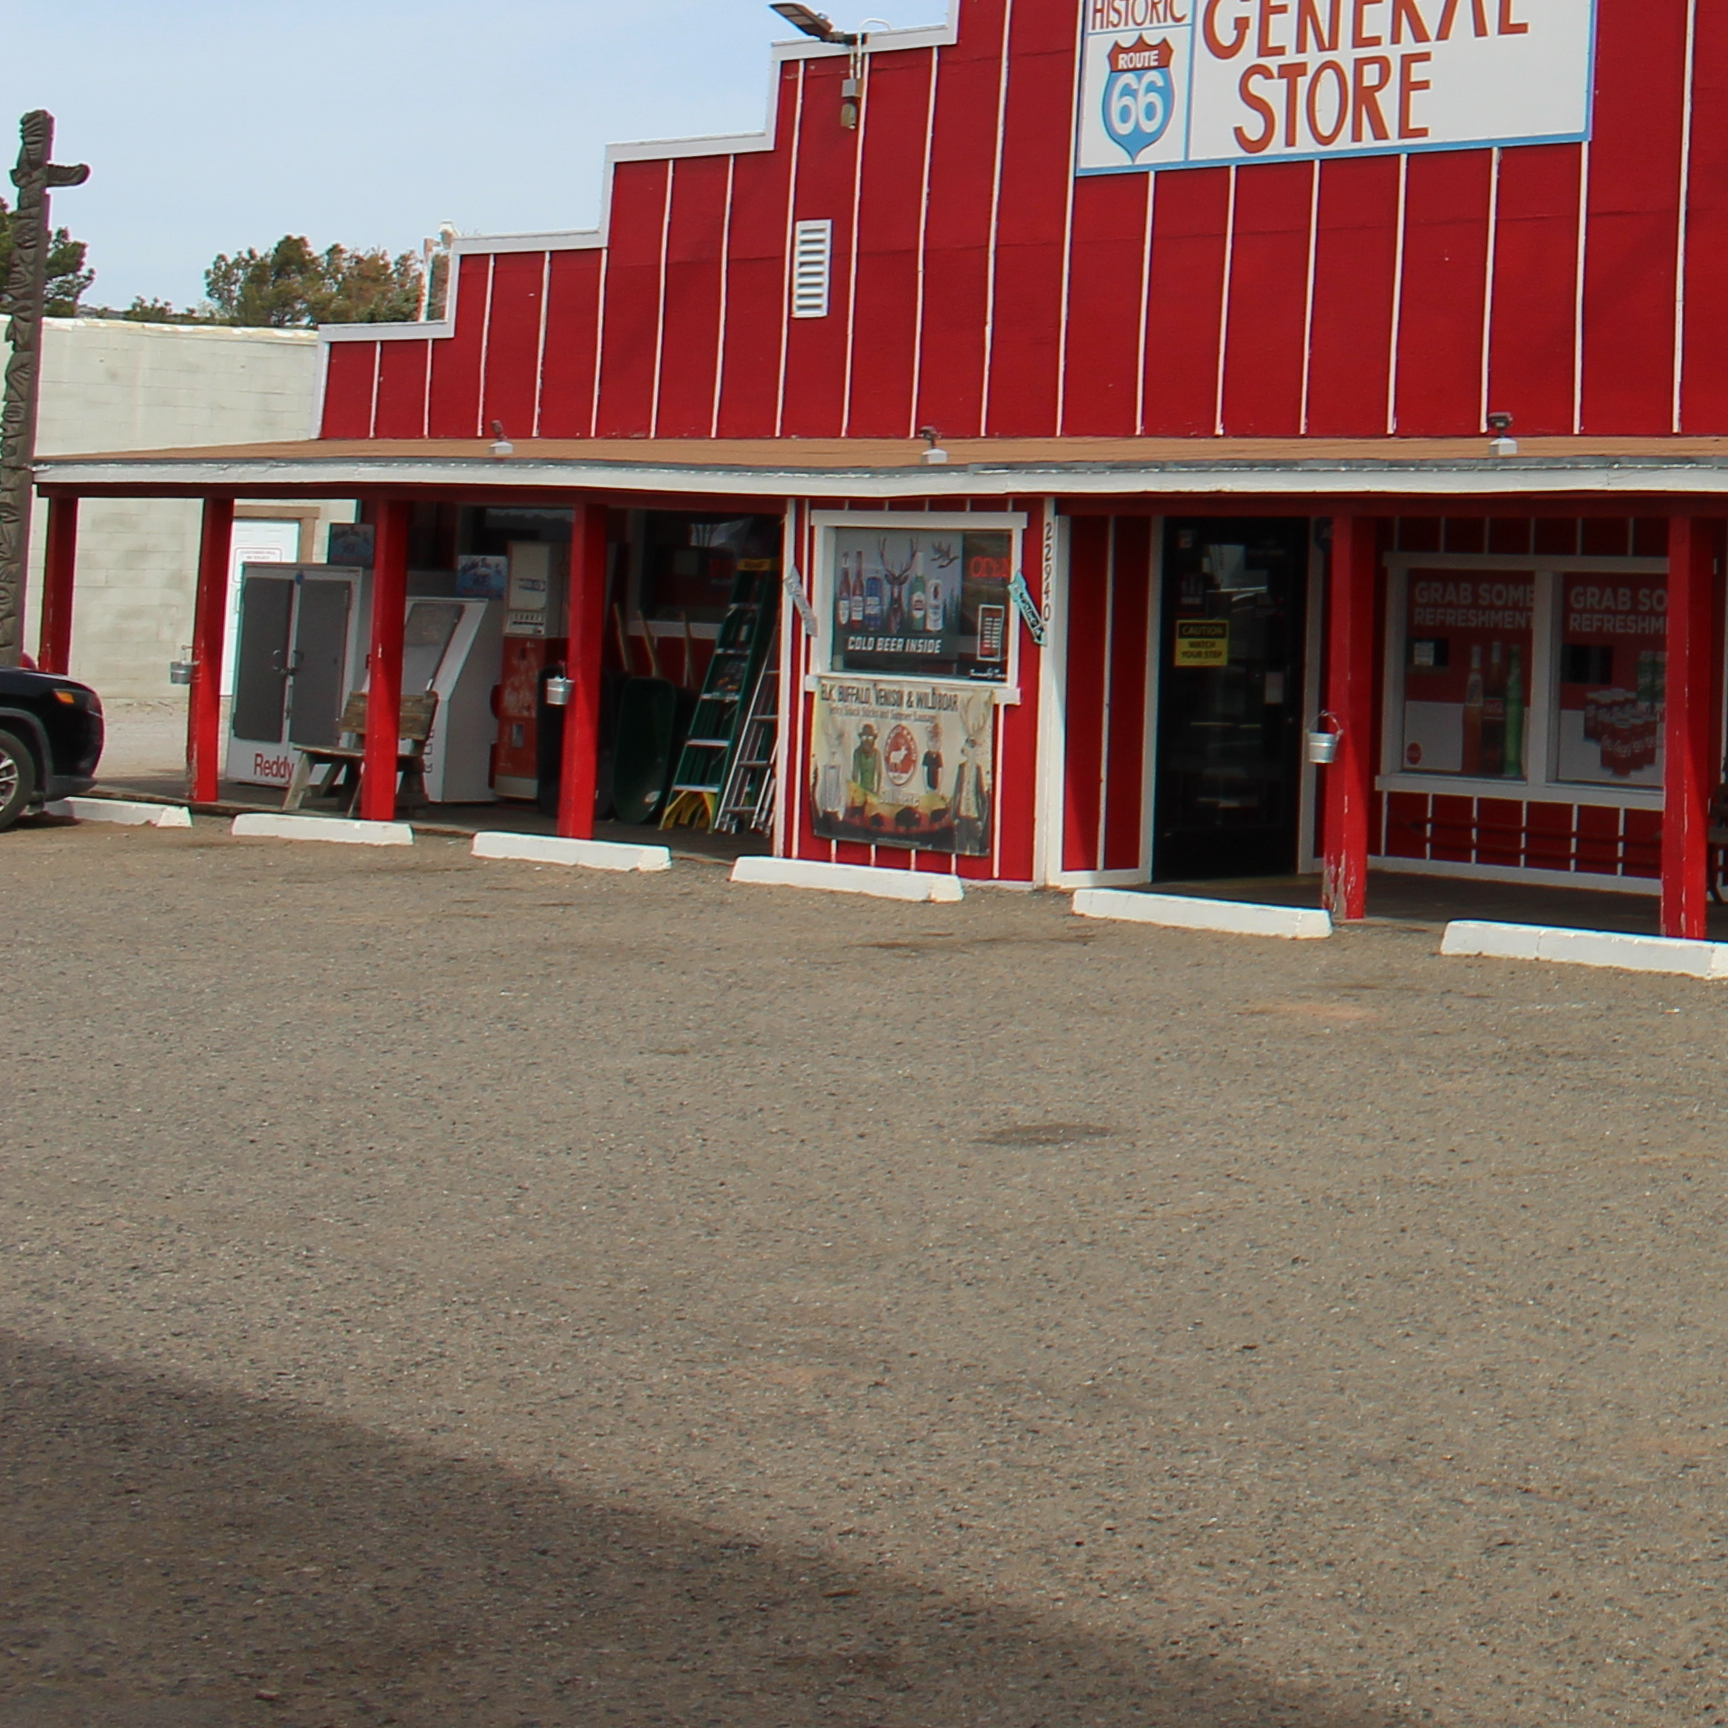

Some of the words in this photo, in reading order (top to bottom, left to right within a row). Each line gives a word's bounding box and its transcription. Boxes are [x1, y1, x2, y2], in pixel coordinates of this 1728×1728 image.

[1117, 49, 1159, 70] ROUTE
[1109, 72, 1165, 136] 66
[1233, 51, 1432, 154] STORE
[1043, 522, 1053, 622] 22940
[1414, 581, 1473, 605] GRAB
[1478, 583, 1535, 607] SOME
[1569, 586, 1632, 611] GRAB
[1413, 607, 1534, 630] REFRESHMENT
[1181, 625, 1224, 636] CAUTION
[848, 636, 874, 651] COLD
[876, 637, 904, 652] BEER
[905, 638, 943, 654] INSIDE
[1181, 650, 1203, 660] YOUR
[1203, 651, 1223, 660] STEP
[1188, 640, 1216, 650] WATCH
[906, 689, 915, 708] &
[253, 752, 295, 784] Reddy
